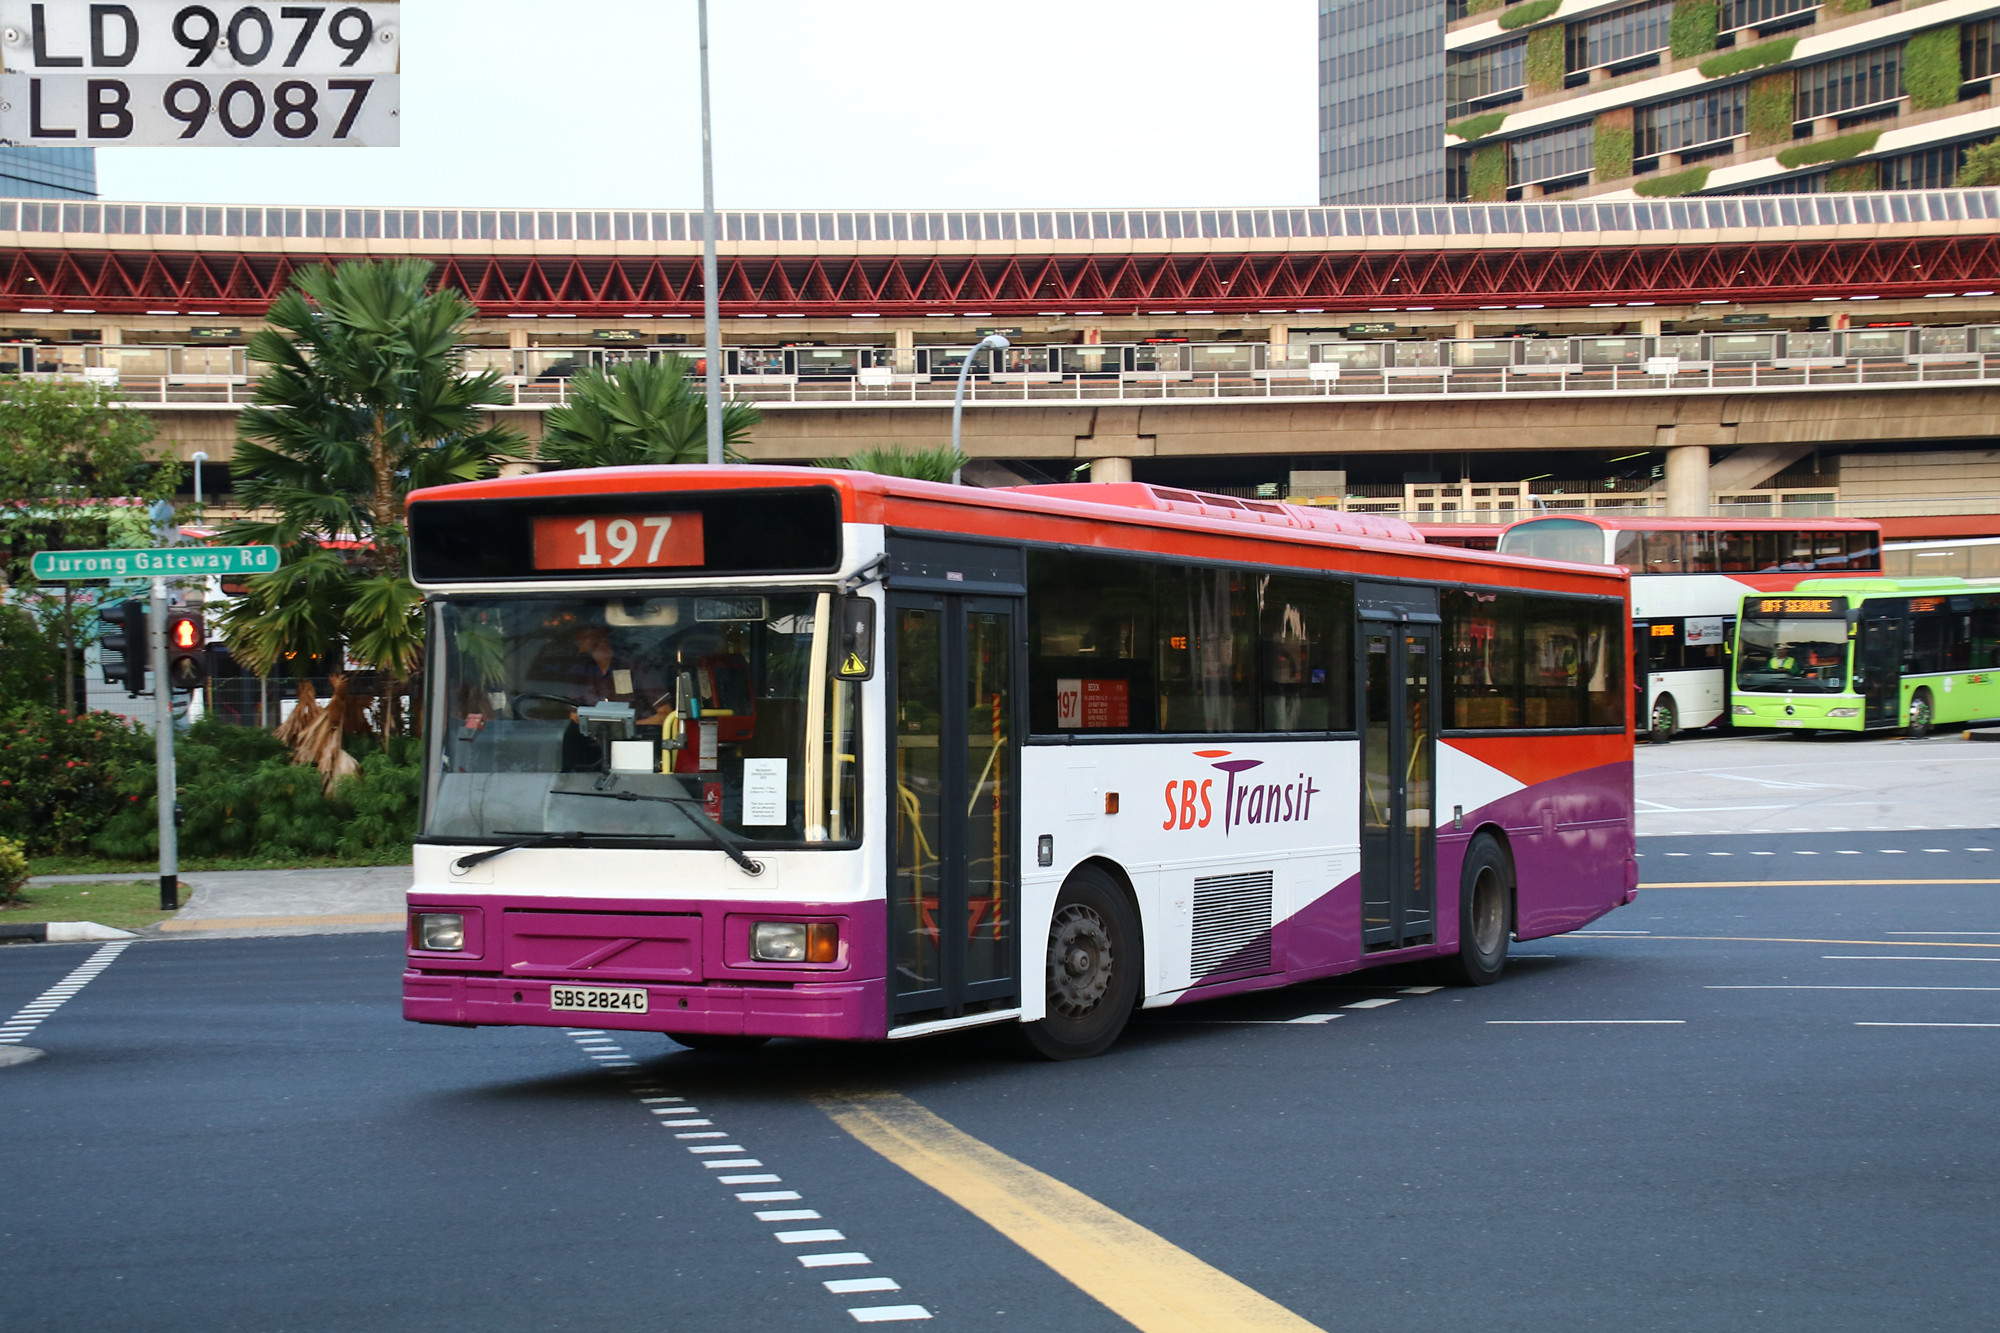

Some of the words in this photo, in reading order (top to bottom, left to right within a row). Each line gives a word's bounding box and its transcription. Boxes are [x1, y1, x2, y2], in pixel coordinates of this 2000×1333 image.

[575, 516, 672, 566] 197
[46, 555, 127, 574] Jurong
[135, 552, 232, 570] Gateway
[241, 549, 267, 566] Rd
[1057, 691, 1078, 718] 197
[1162, 779, 1213, 831] SBS
[1210, 759, 1321, 838] Transit
[554, 990, 644, 1009] SBS2824C
